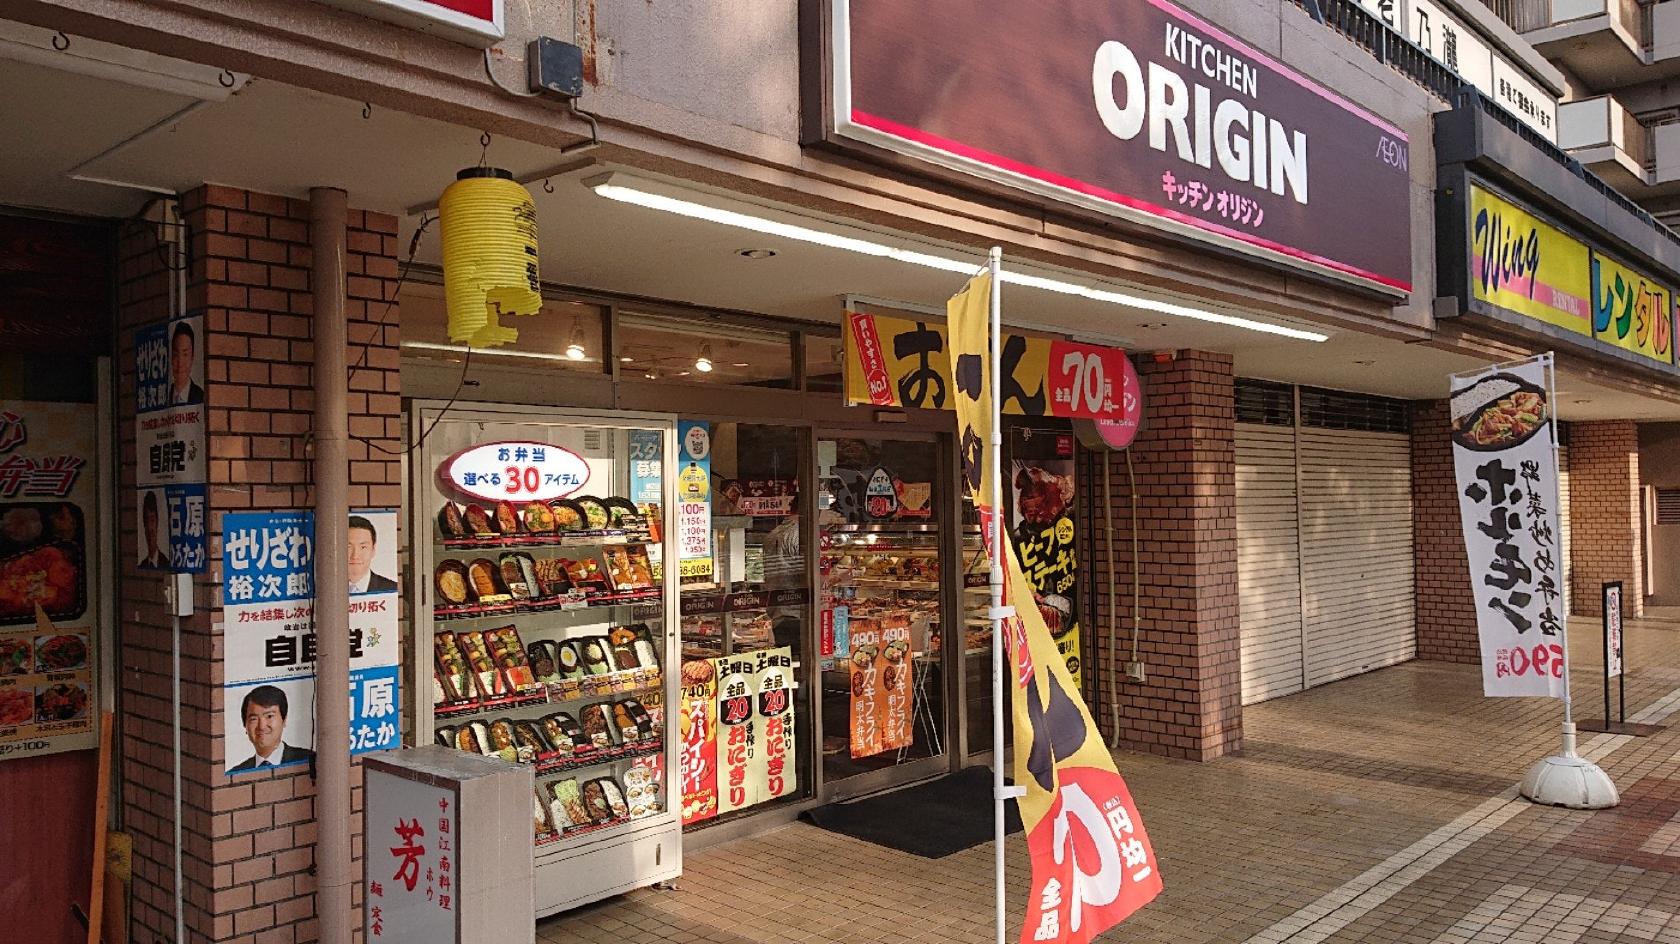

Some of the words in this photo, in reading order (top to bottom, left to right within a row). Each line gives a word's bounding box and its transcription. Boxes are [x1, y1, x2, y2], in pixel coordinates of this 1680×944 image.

[1165, 22, 1257, 99] KITCHEN
[1091, 40, 1308, 205] ORIGIN
[1475, 207, 1540, 300] Wing
[1594, 258, 1670, 355] レンタル
[498, 447, 546, 462] お弁当
[168, 495, 204, 538] 石原
[226, 526, 312, 570] せりざわ
[1019, 525, 1055, 568] ビーフ
[228, 572, 310, 600] 裕次郎
[685, 602, 714, 611] ORIGIN
[733, 597, 760, 607] ORIGIN
[720, 661, 753, 682] 土曜日
[755, 653, 791, 674] 土曜日
[763, 675, 783, 690] 全品
[349, 676, 395, 720] 原
[726, 682, 745, 698] 全品
[727, 698, 748, 720] 20
[764, 689, 785, 713] 20
[862, 661, 877, 747] カキフライ
[893, 657, 908, 739] カキフライ
[689, 700, 706, 791] スパイシー
[746, 721, 755, 759] 手作り
[783, 712, 793, 750] 手作り
[727, 725, 748, 807] おにぎり
[765, 717, 785, 796] おにぎり
[390, 817, 426, 892] 芳
[438, 797, 452, 911] 中国江南料理
